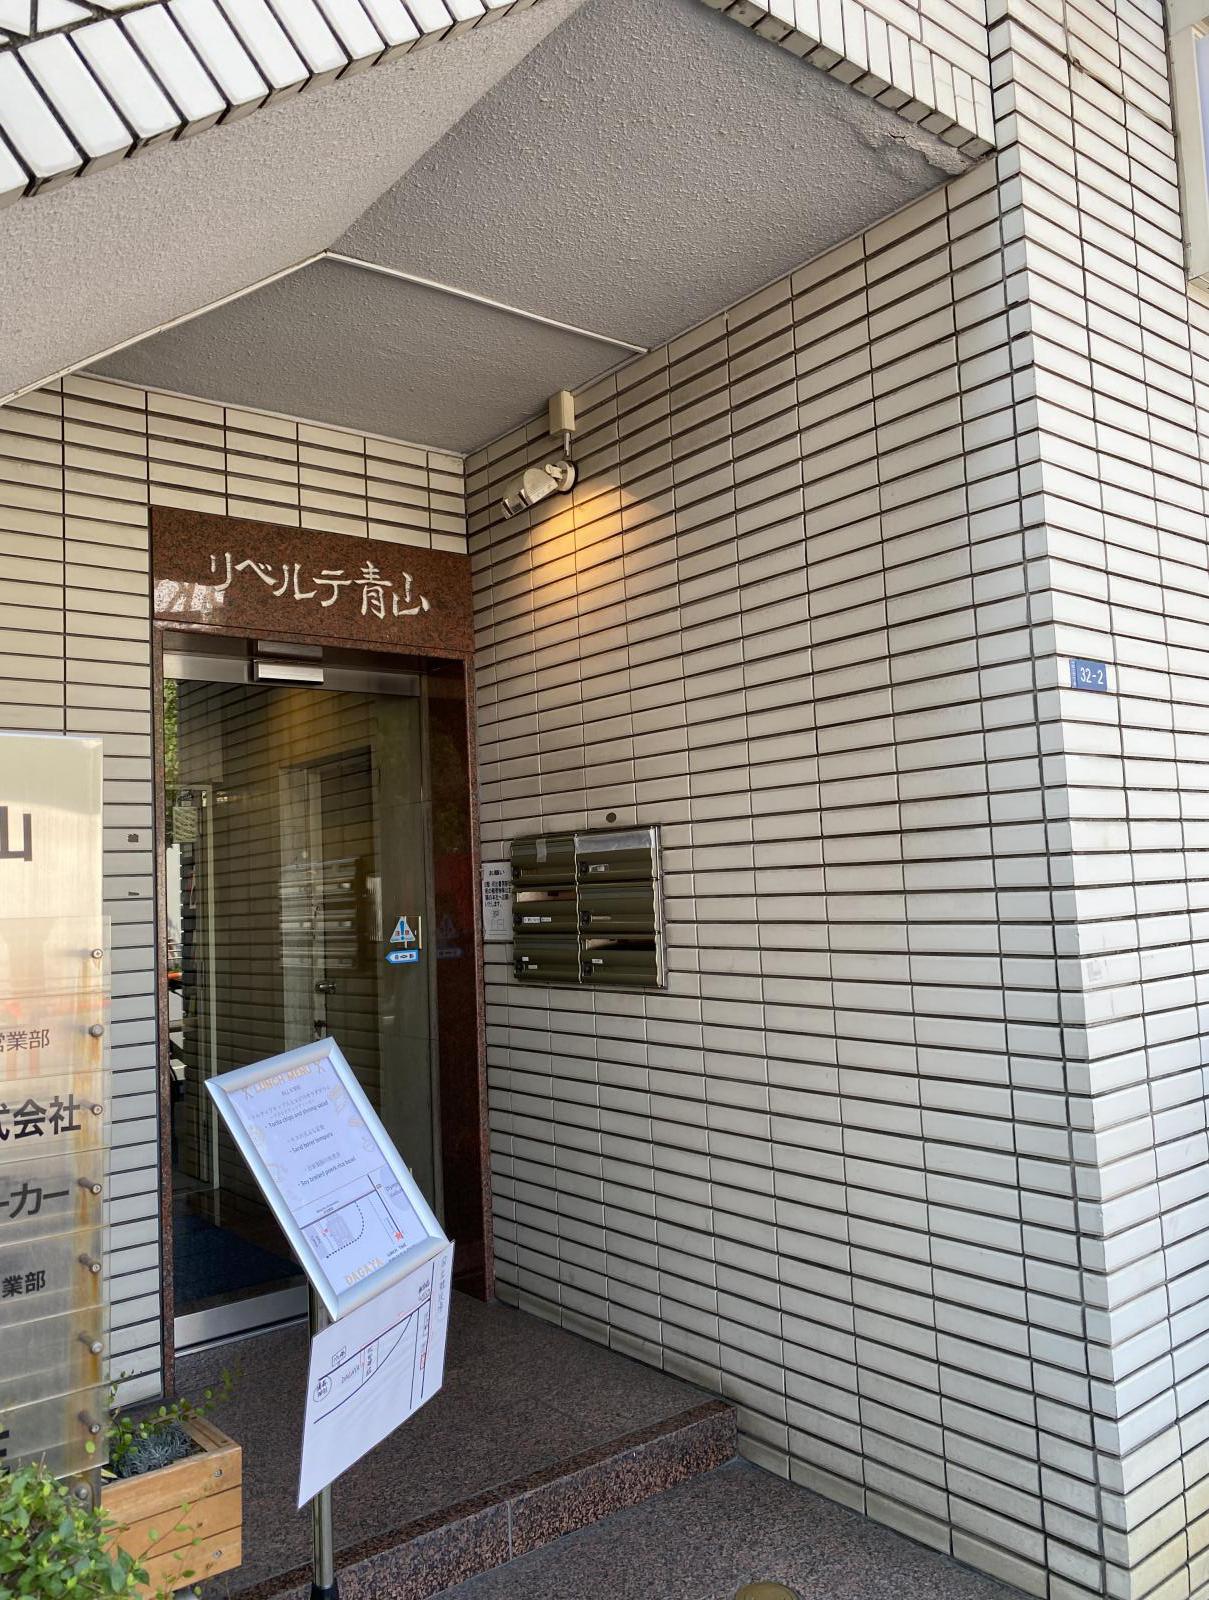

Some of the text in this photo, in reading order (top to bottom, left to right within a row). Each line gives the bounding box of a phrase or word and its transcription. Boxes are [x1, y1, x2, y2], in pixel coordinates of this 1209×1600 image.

[210, 552, 431, 619] リベルテ青山
[1080, 667, 1104, 685] 32-2
[0, 1029, 50, 1050] 業部
